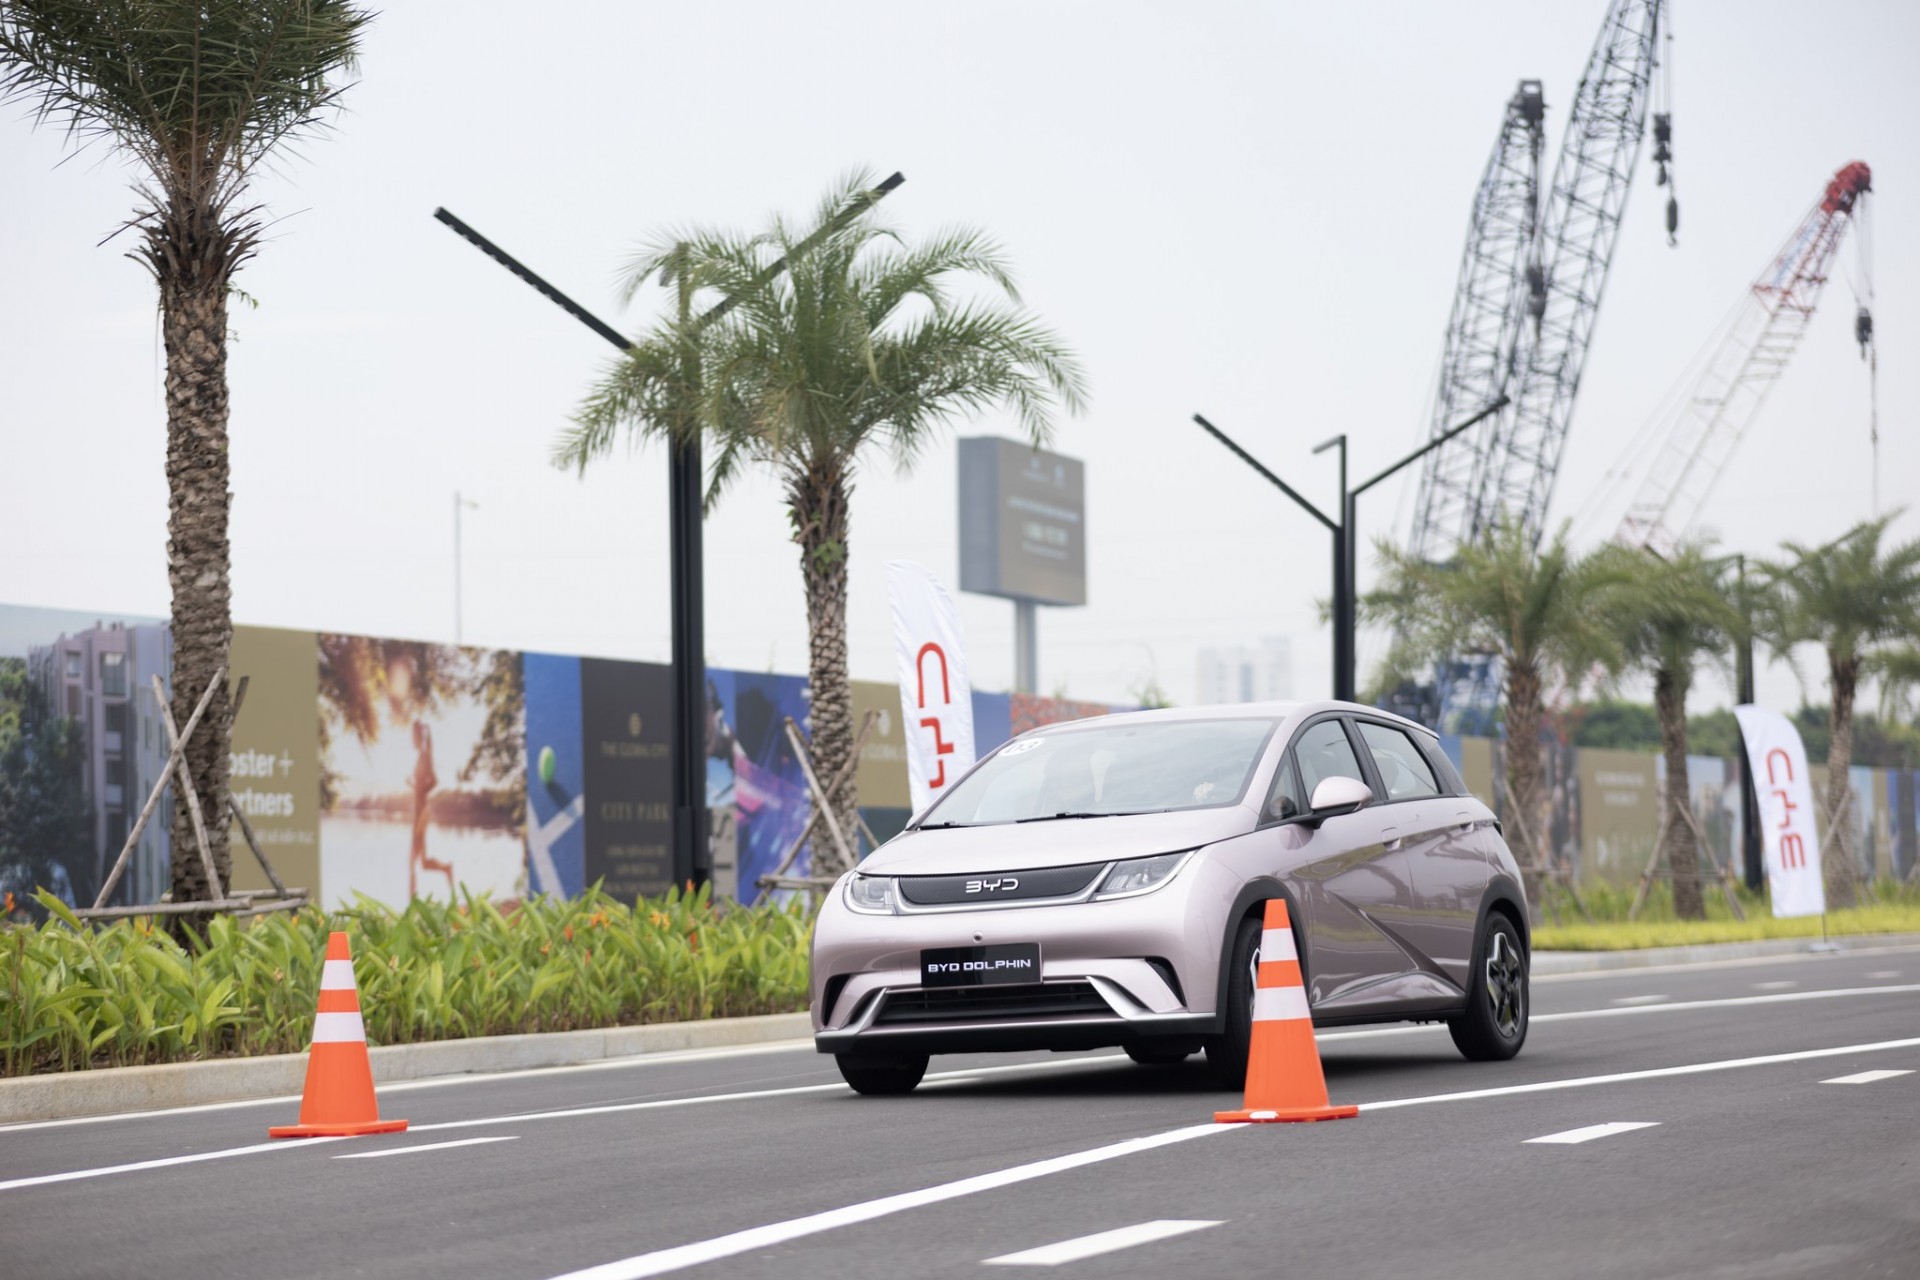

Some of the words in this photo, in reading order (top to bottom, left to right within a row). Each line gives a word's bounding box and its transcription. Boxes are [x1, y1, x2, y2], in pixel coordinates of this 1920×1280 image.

[916, 641, 955, 789] YD
[229, 748, 276, 777] oster
[602, 802, 632, 821] CITY
[637, 803, 670, 821] PARK
[965, 878, 1019, 893] BYD
[928, 963, 960, 973] BYD
[963, 959, 1031, 971] DOLPHIN
